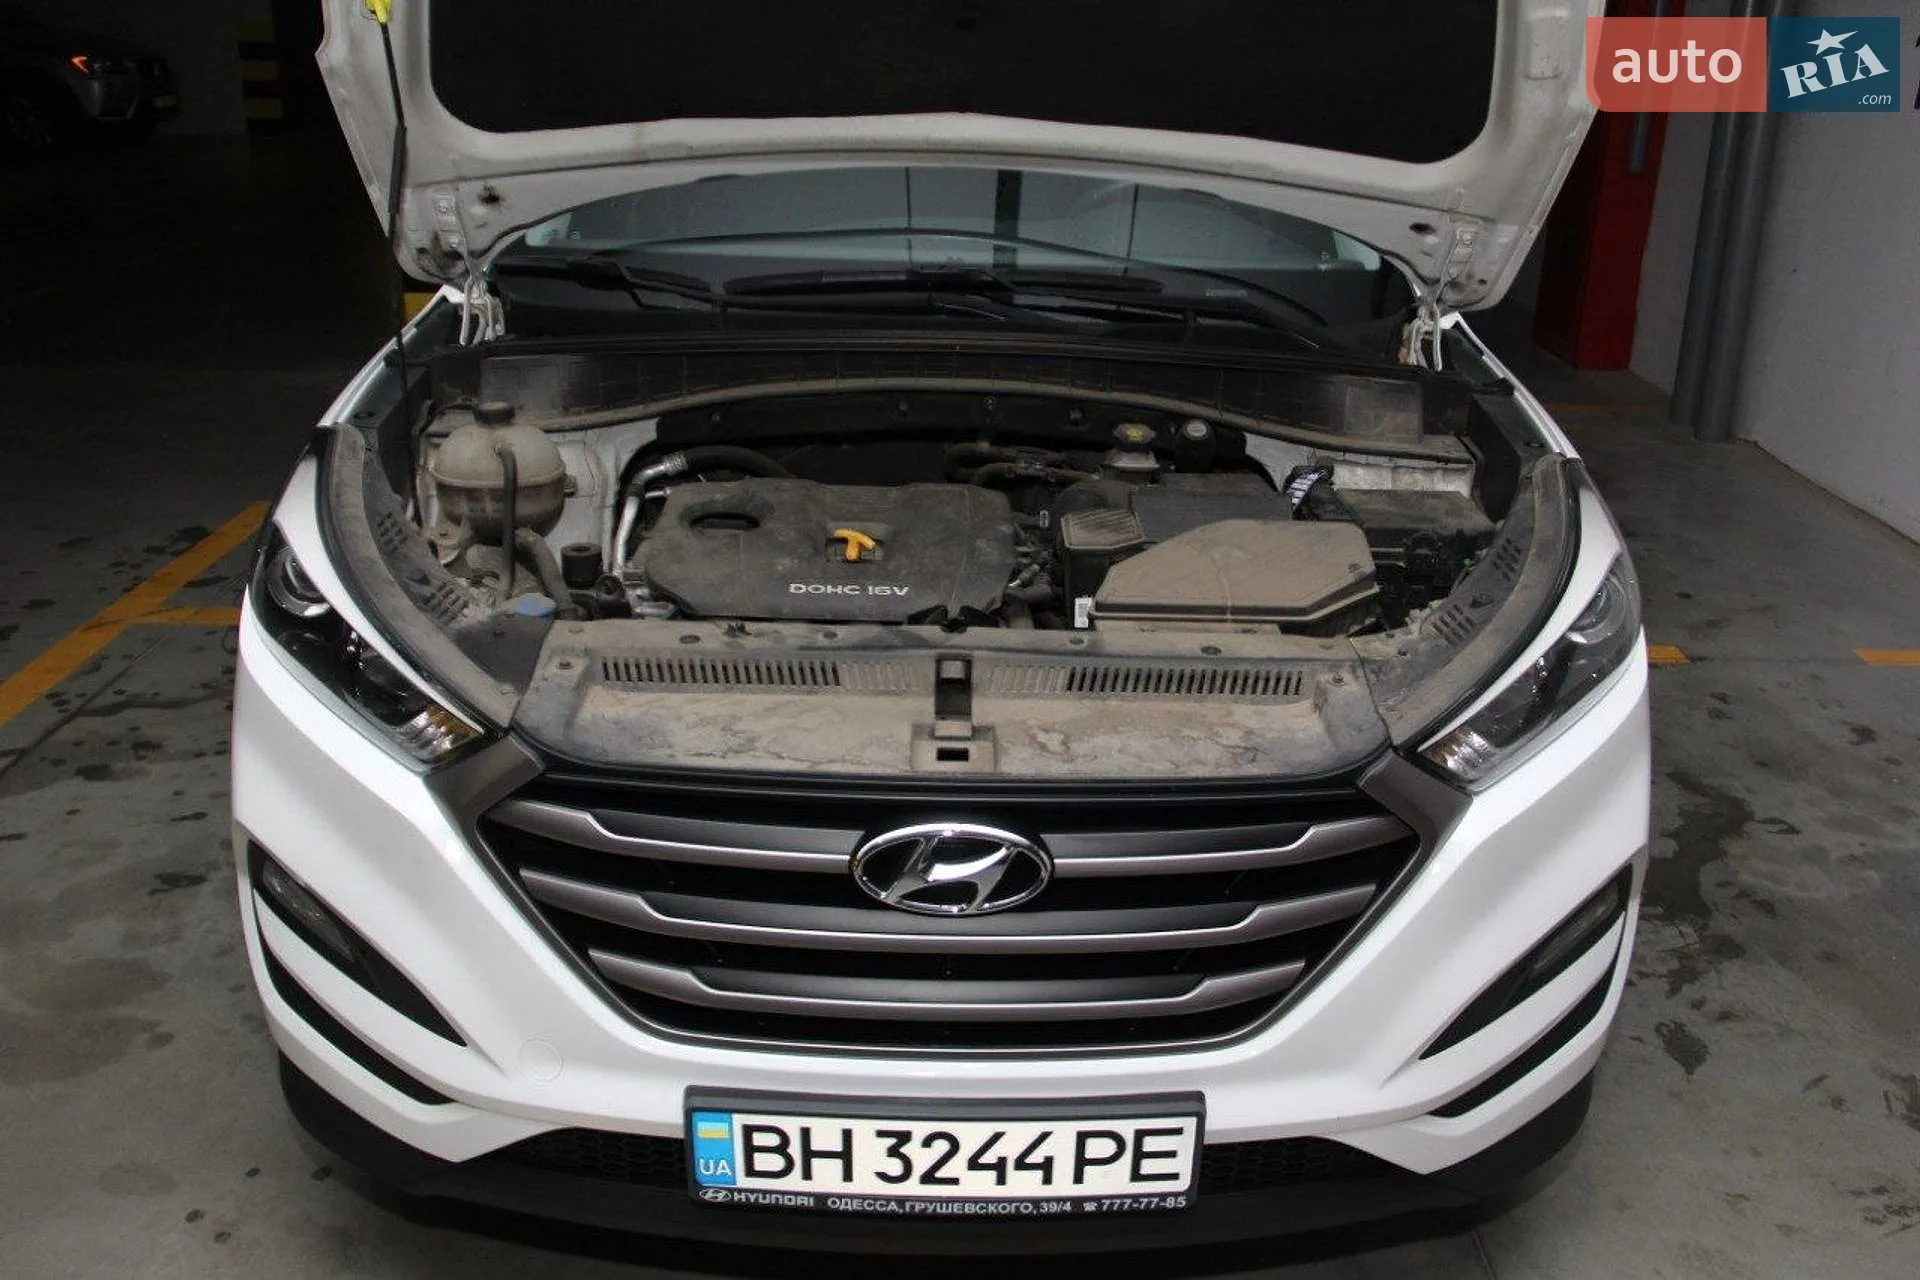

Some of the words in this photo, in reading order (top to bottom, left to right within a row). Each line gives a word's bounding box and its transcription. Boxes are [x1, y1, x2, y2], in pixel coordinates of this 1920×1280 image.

[789, 583, 861, 595] DOHC
[867, 585, 909, 596] 16V
[743, 1123, 853, 1183] BH
[874, 1129, 1054, 1186] 3244
[1072, 1126, 1184, 1185] PE
[699, 1159, 732, 1177] UA
[733, 1191, 814, 1207] HYUNDAI
[1101, 1196, 1187, 1211] 777-77-85
[1040, 1202, 1072, 1213] 39/4
